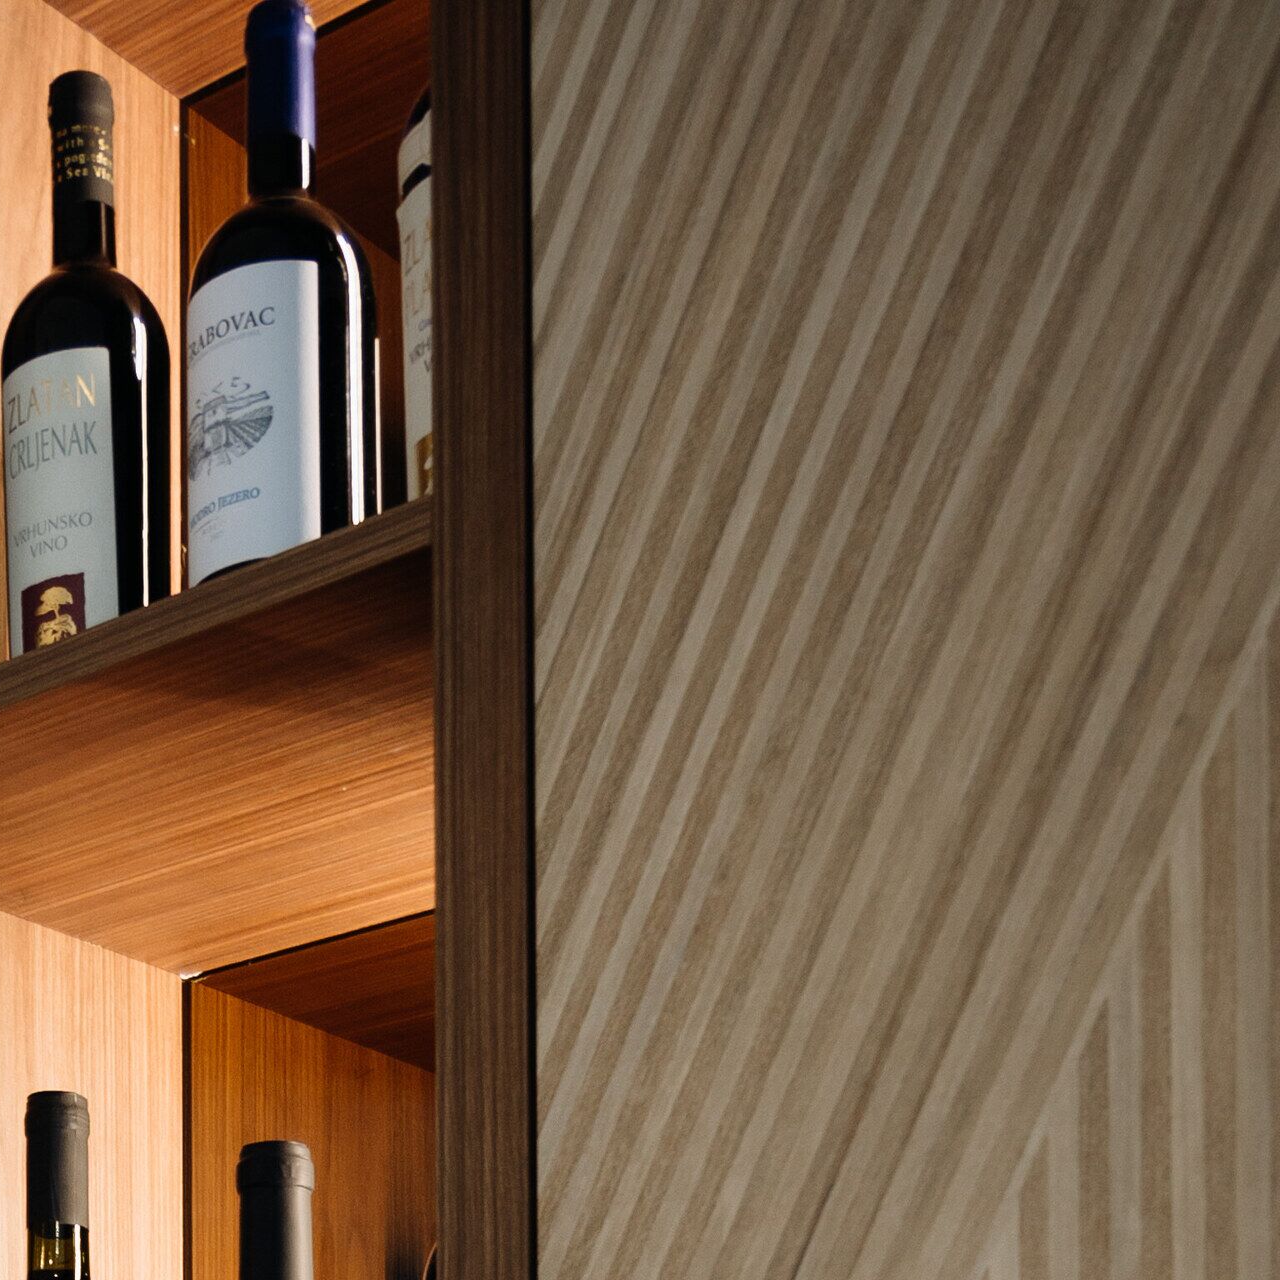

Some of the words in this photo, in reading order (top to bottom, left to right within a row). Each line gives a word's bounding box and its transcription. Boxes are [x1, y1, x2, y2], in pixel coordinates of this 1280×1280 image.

[189, 305, 276, 363] RABOVAC
[7, 372, 97, 436] ZLATAN
[7, 420, 98, 481] CRLJENAK
[13, 510, 94, 549] VRHUNSKO
[30, 534, 68, 559] VINO
